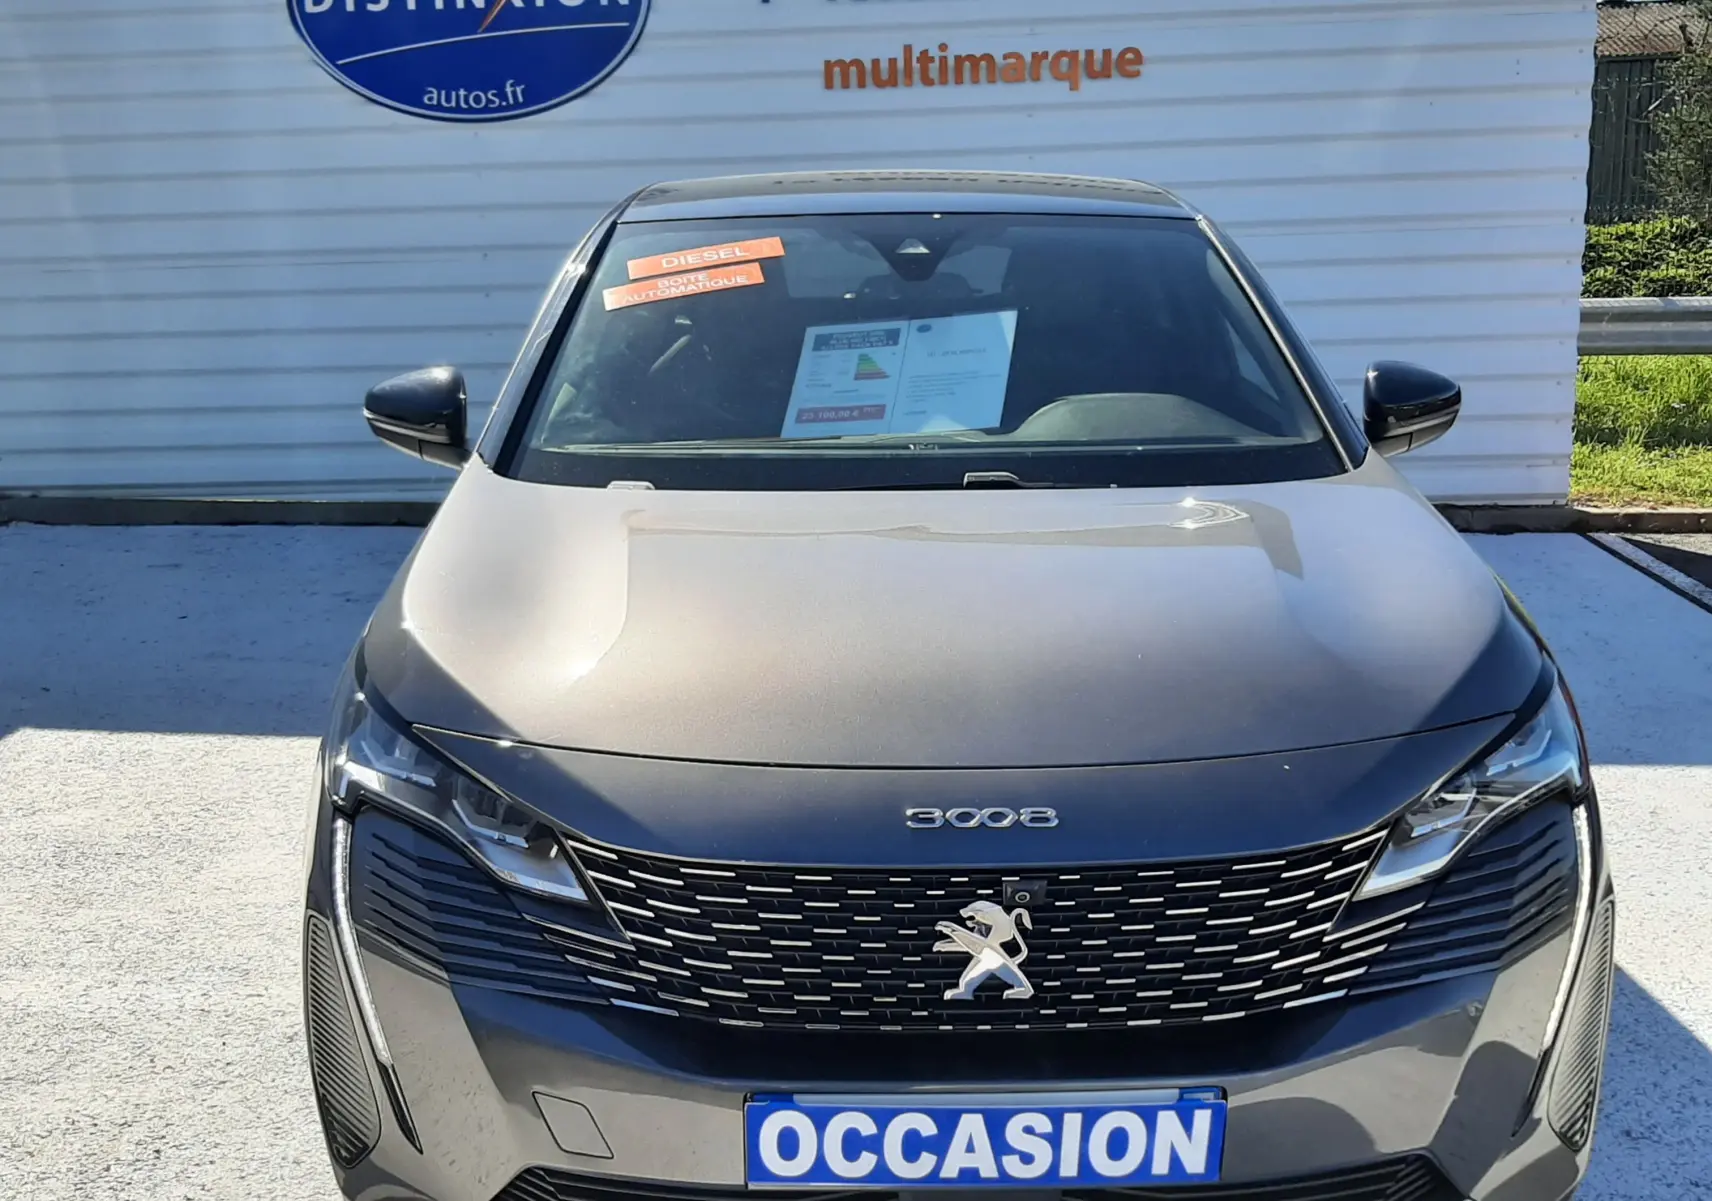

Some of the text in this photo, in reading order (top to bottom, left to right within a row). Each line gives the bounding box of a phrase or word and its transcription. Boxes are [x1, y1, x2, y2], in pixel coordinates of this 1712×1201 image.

[823, 42, 1144, 91] multimarque
[423, 79, 525, 109] autos.fr
[660, 247, 749, 268] DIESEL
[624, 275, 749, 303] AUTOMATIQUE
[657, 273, 708, 288] BOITE
[905, 807, 1060, 828] 3008
[758, 1108, 1213, 1180] OCCASION
